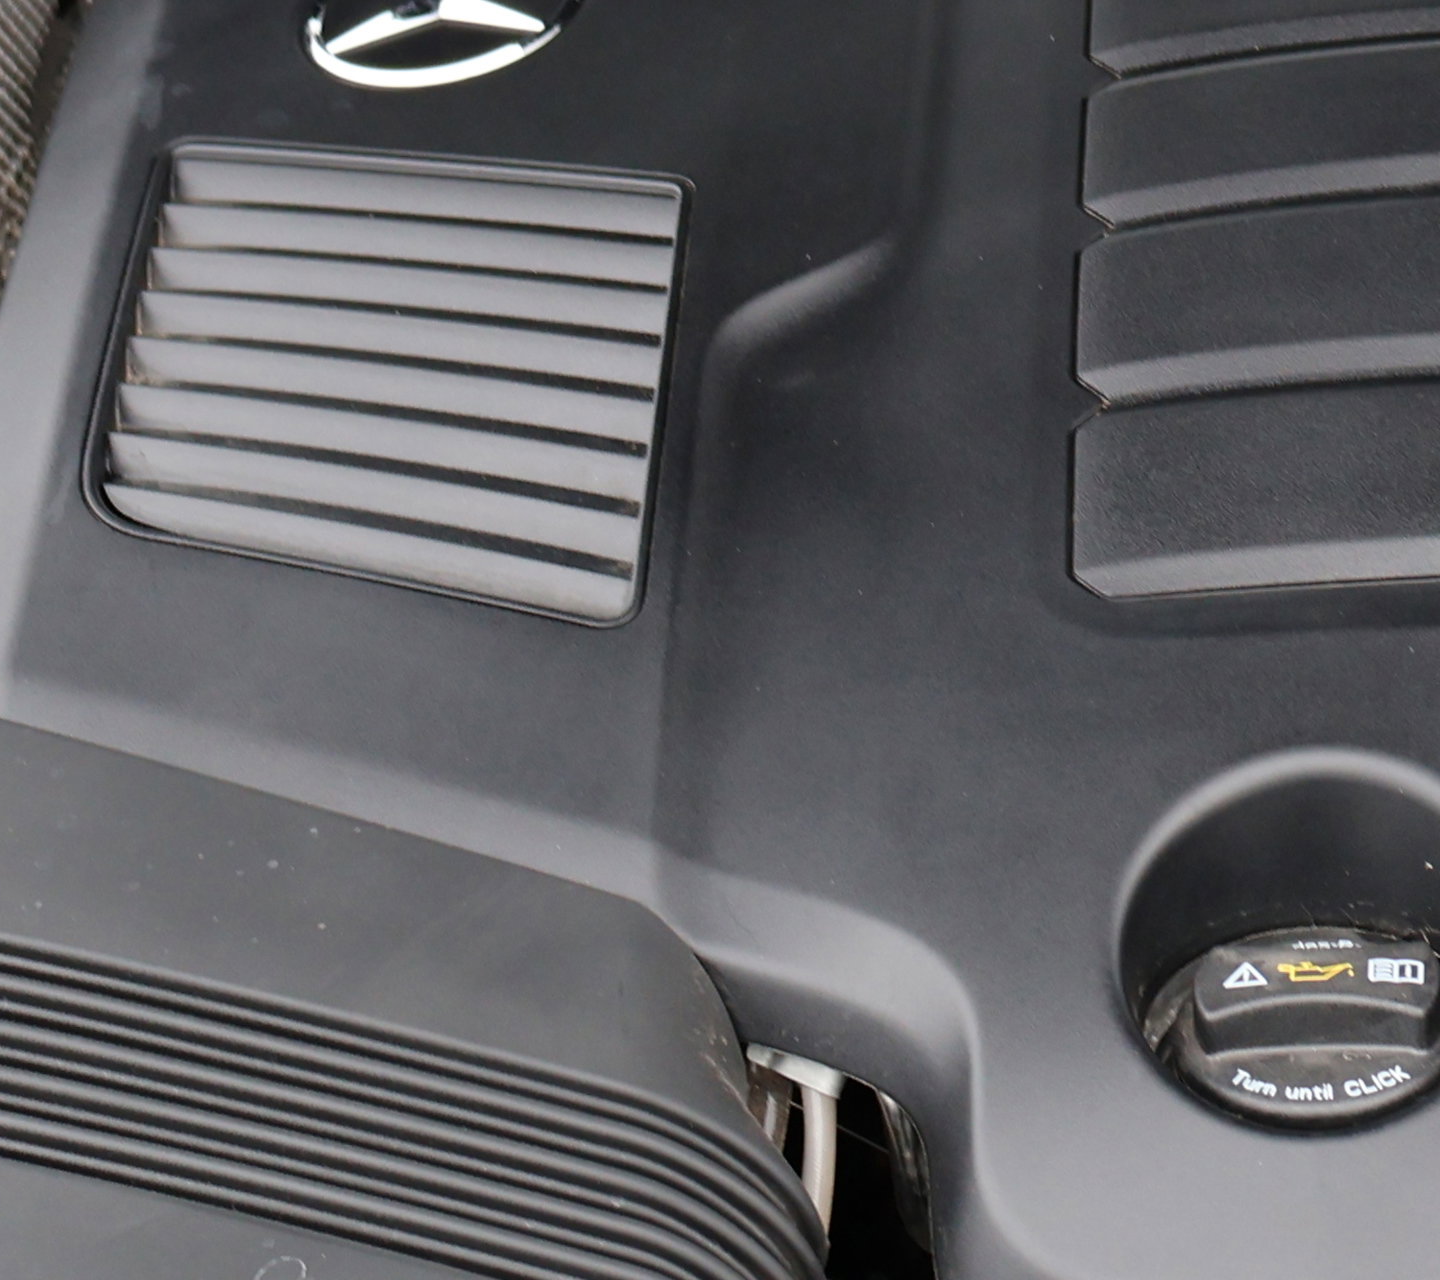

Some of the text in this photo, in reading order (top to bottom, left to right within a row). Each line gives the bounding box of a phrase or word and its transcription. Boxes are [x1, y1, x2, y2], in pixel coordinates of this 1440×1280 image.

[1231, 1064, 1411, 1101] Turn until CLICK
